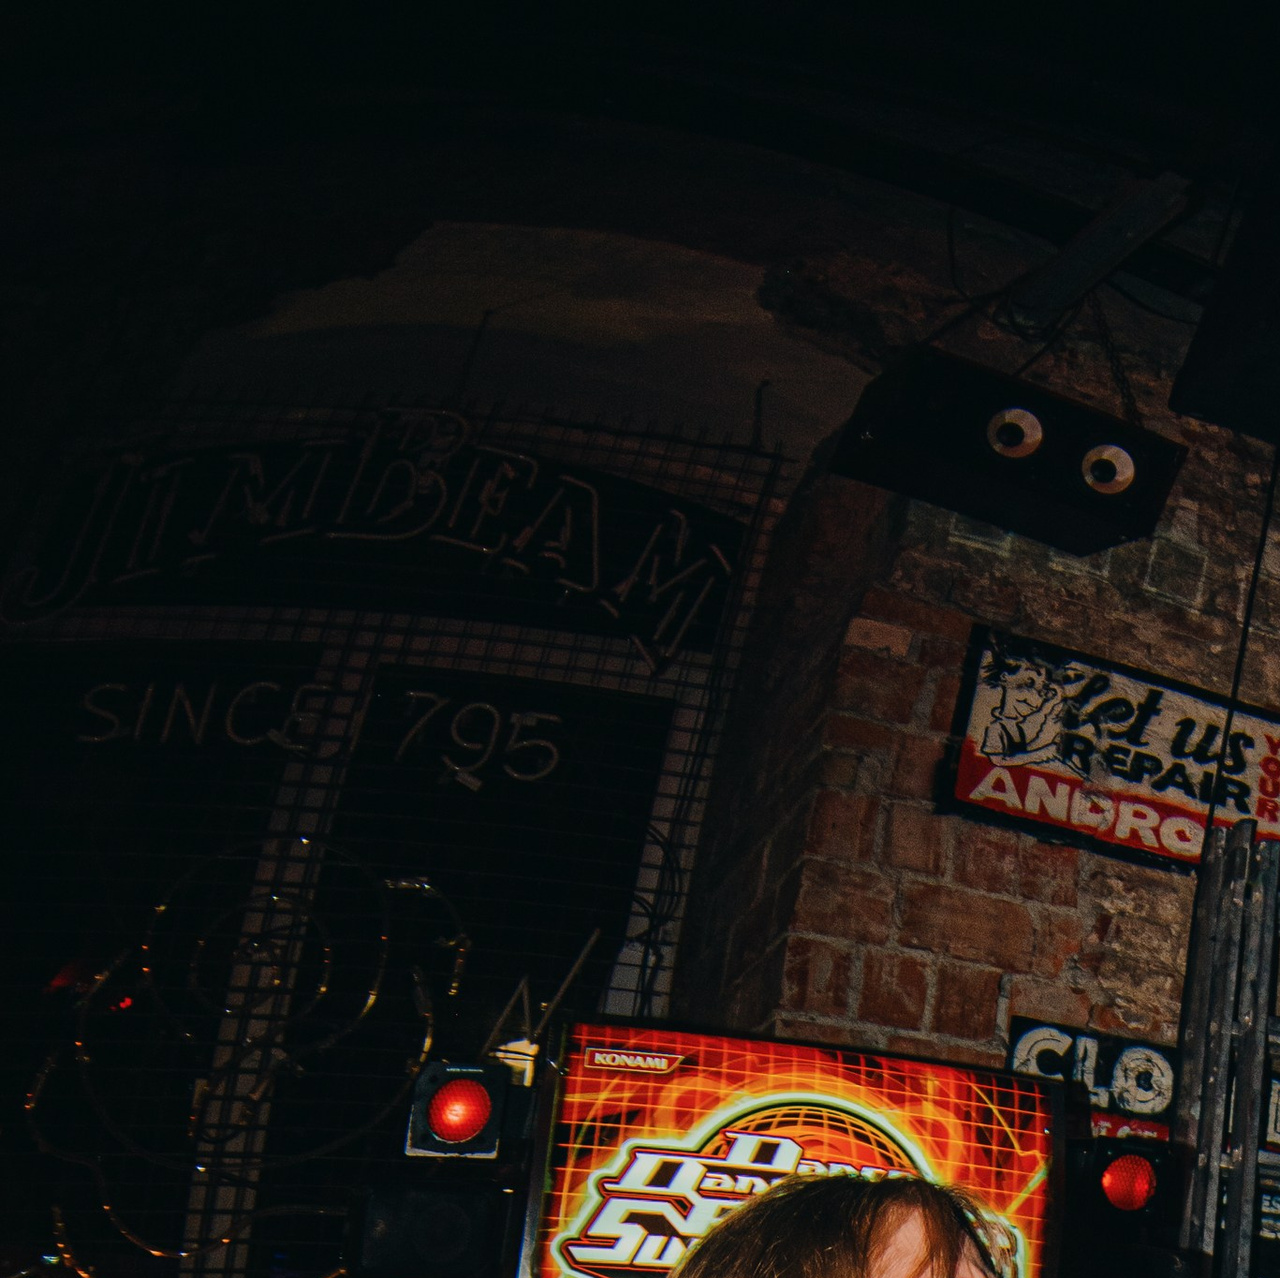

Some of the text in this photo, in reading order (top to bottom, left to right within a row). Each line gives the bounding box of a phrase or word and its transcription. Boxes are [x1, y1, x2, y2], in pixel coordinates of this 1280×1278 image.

[1062, 733, 1252, 814] REPAIR
[1170, 717, 1255, 775] us
[968, 767, 1206, 859] ANDRO
[594, 1052, 669, 1071] KONAMI
